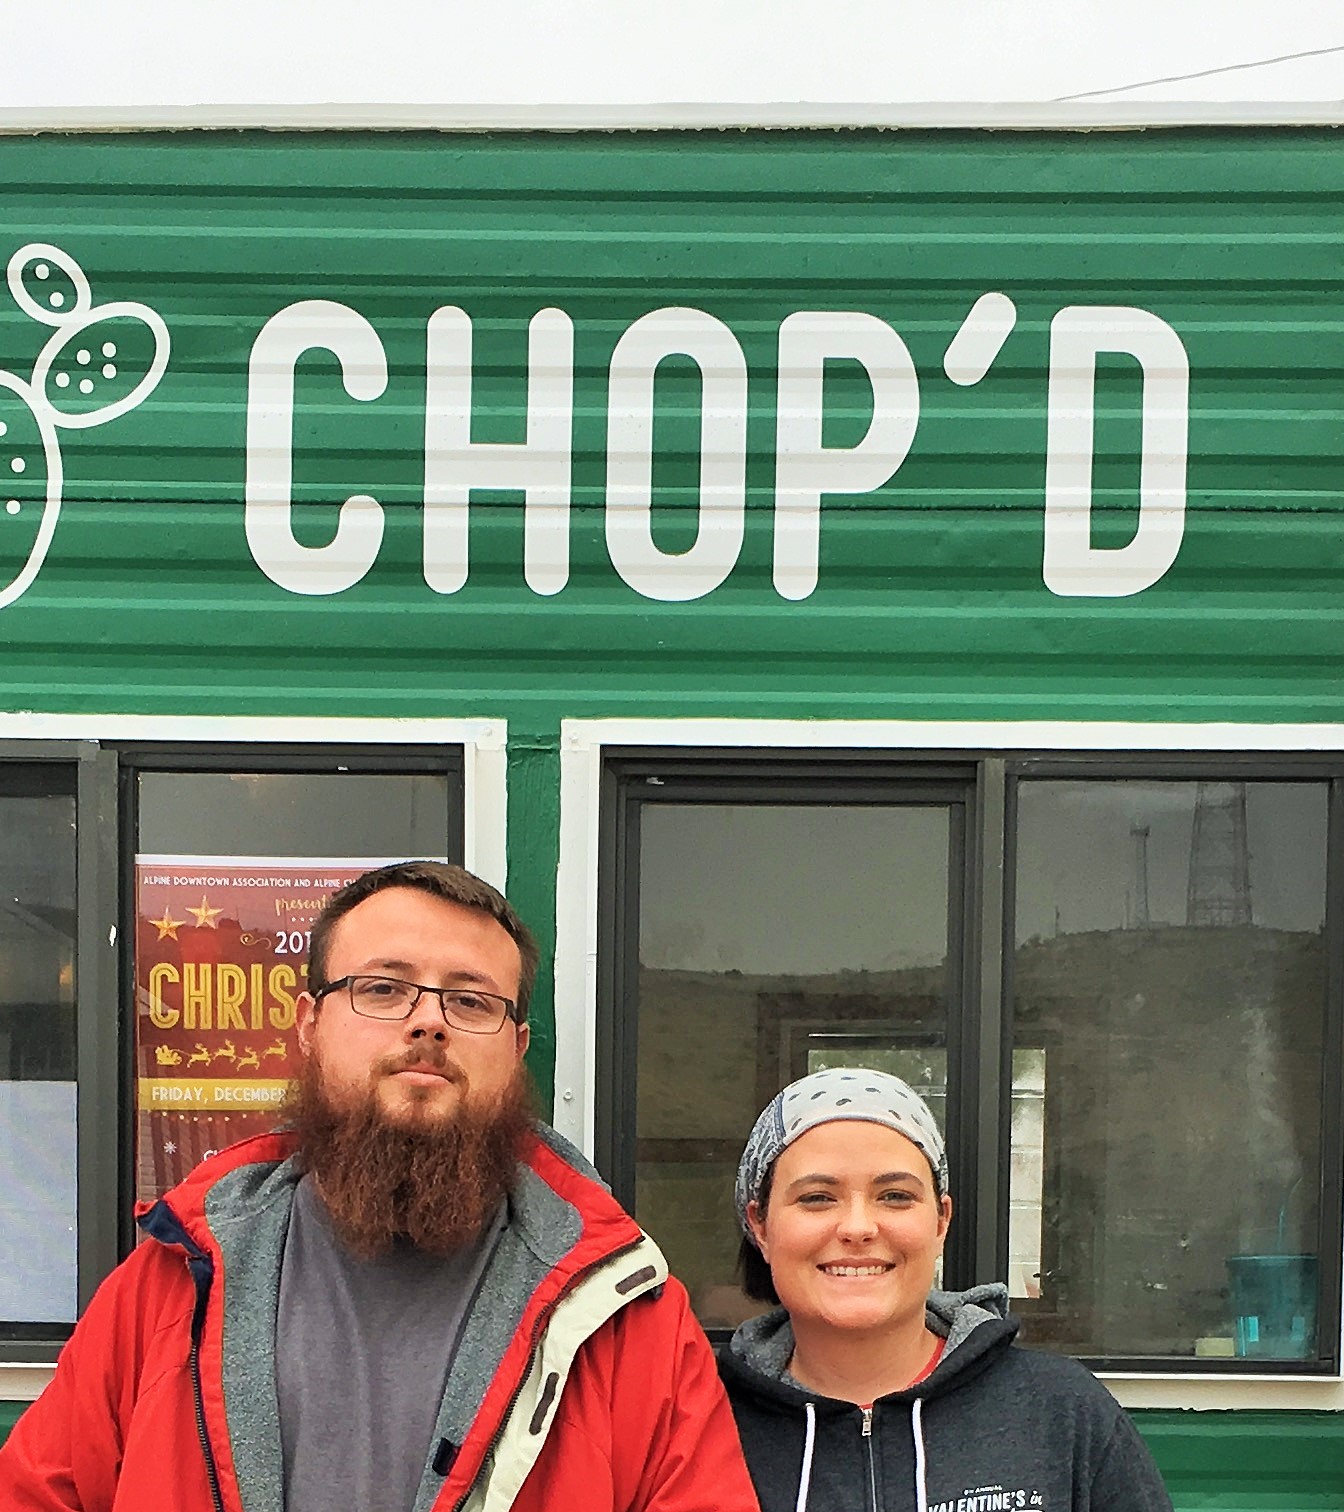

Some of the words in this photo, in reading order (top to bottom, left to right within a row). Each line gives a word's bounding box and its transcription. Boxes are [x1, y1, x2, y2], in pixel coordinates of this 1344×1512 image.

[246, 291, 1190, 600] CHOP'D
[144, 876, 171, 885] ALPINE
[174, 877, 229, 886] DOWNTOWN
[232, 878, 291, 887] ASSOCIATION
[294, 879, 310, 887] AND
[313, 879, 340, 887] ALPINE
[275, 931, 311, 953] 201
[149, 962, 308, 1030] CHRIS
[152, 1086, 207, 1104] FRIDAY,
[1030, 1490, 1042, 1505] in
